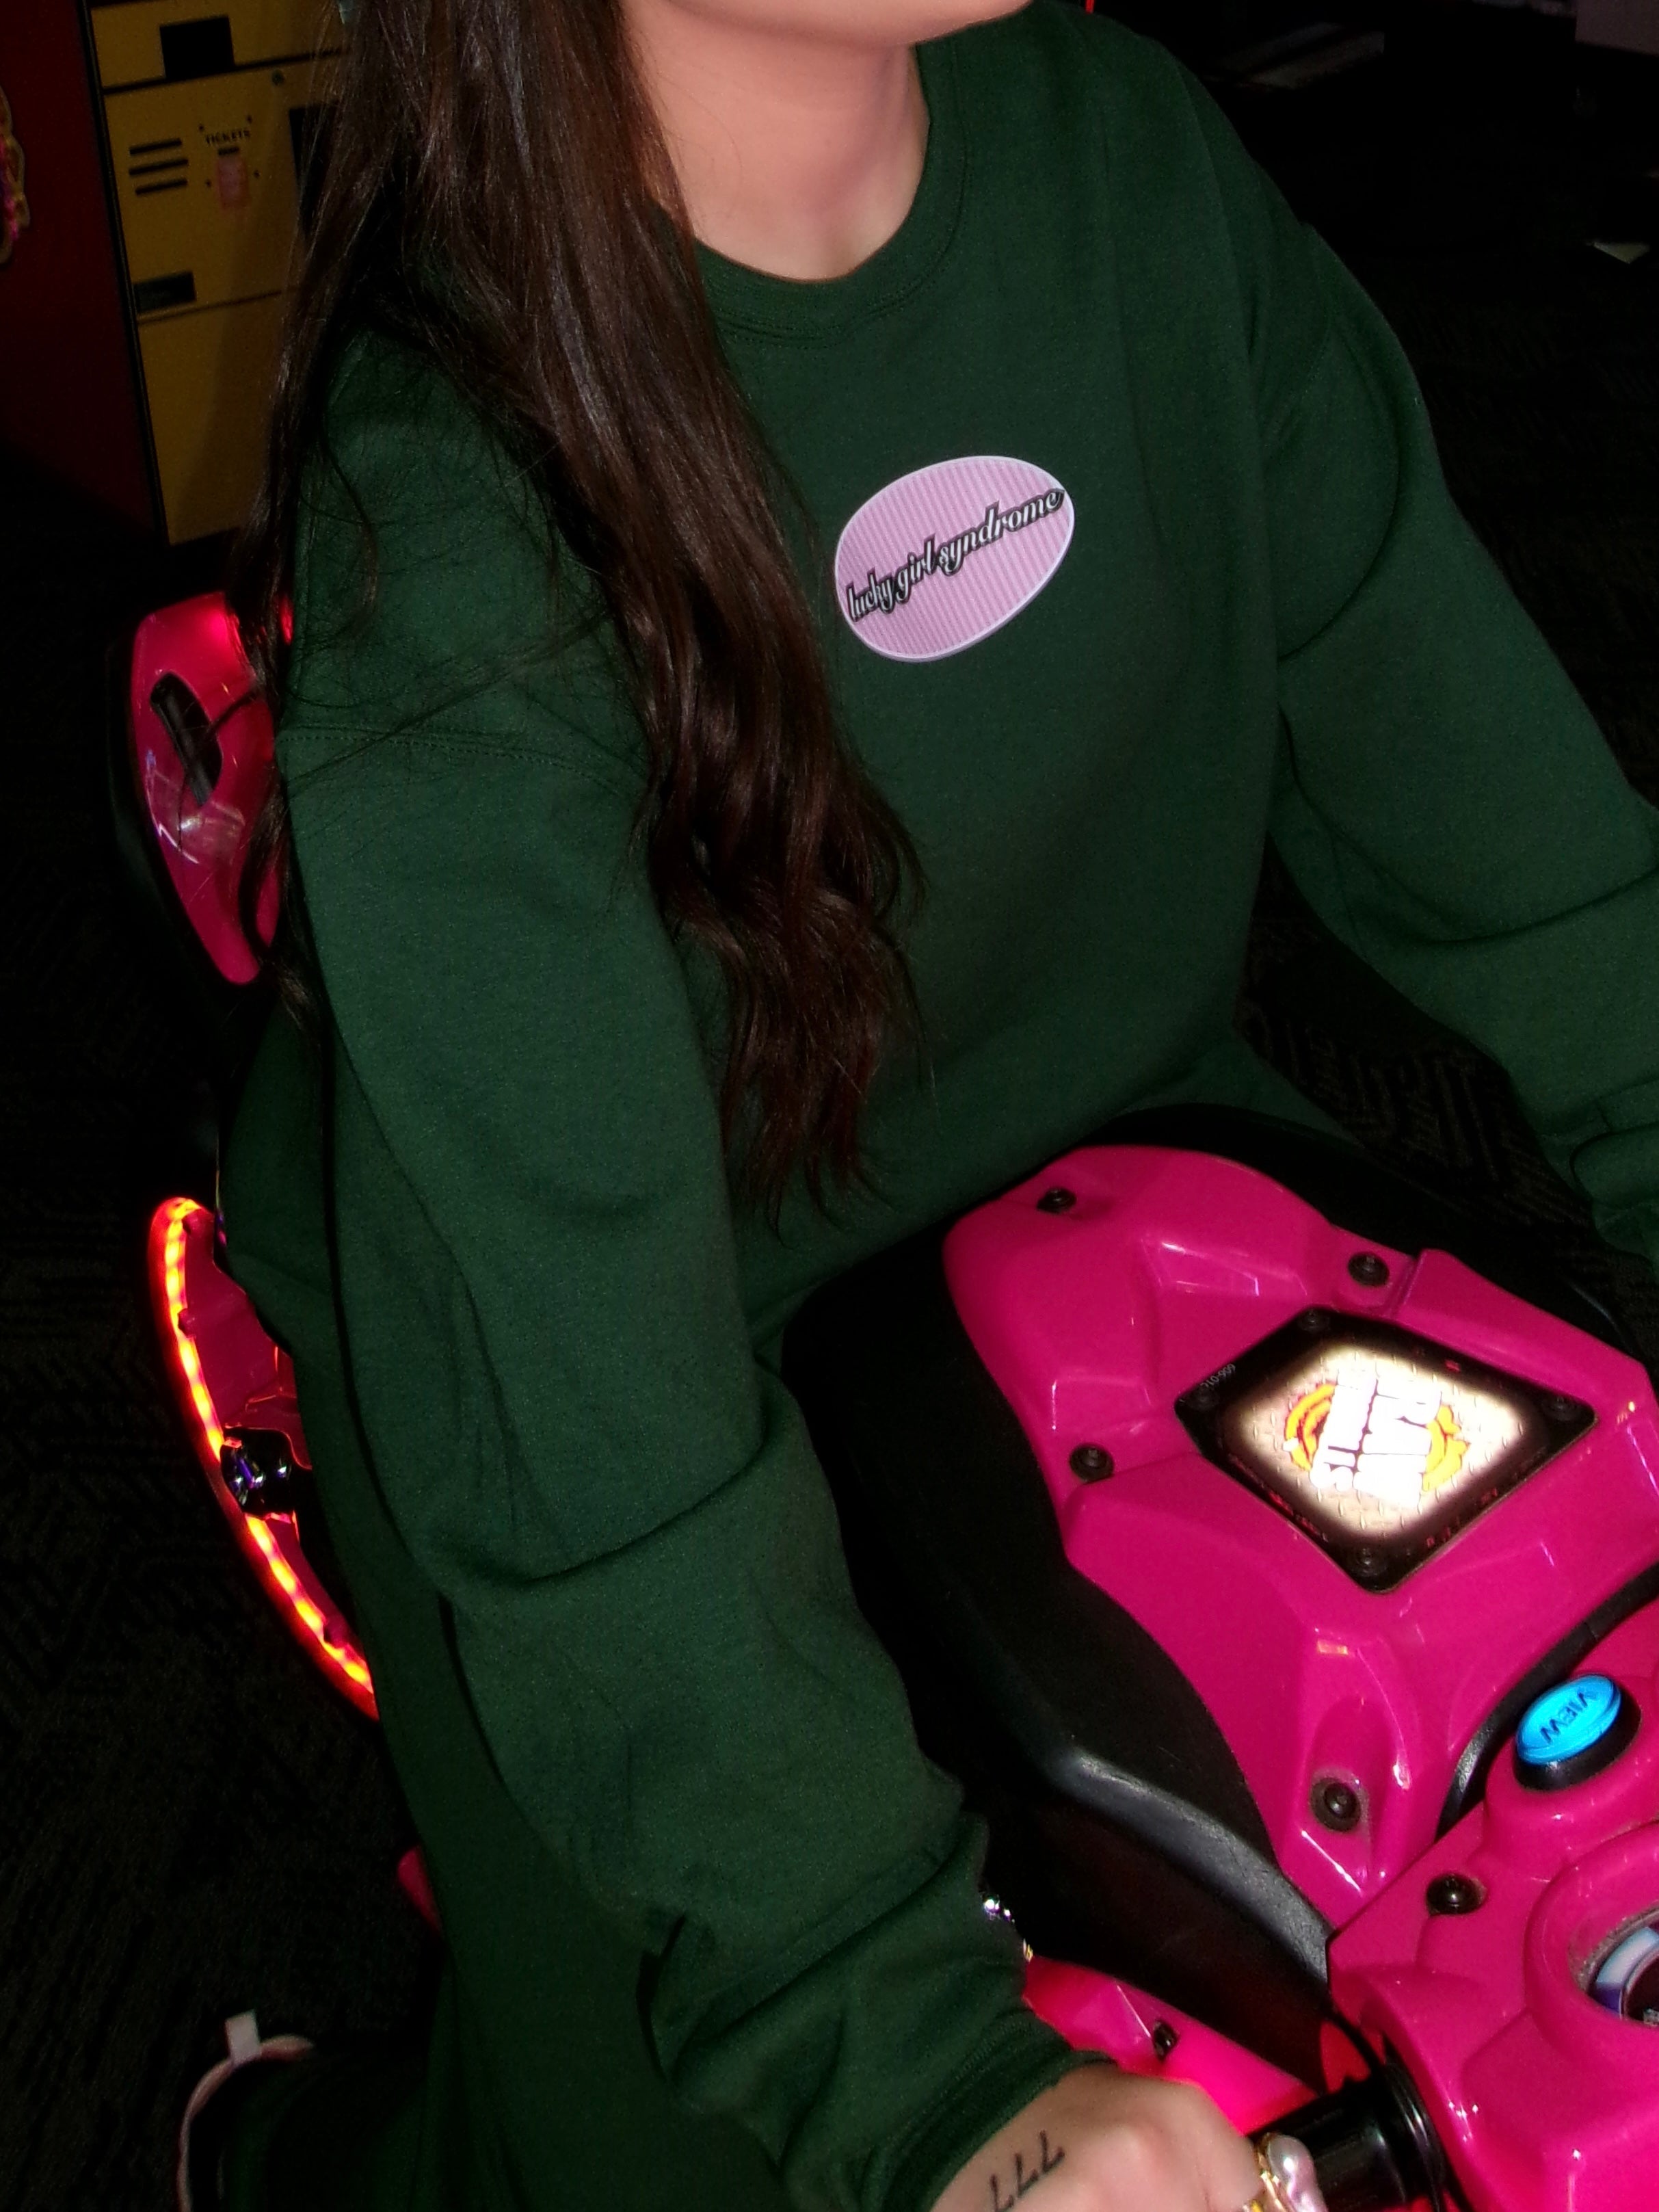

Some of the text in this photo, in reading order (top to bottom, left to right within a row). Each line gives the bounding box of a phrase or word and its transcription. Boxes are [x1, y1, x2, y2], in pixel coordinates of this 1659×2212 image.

[205, 130, 250, 145] TICKETS
[846, 488, 1065, 622] lucky girl syndrome
[1540, 1687, 1597, 1743] VIEW
